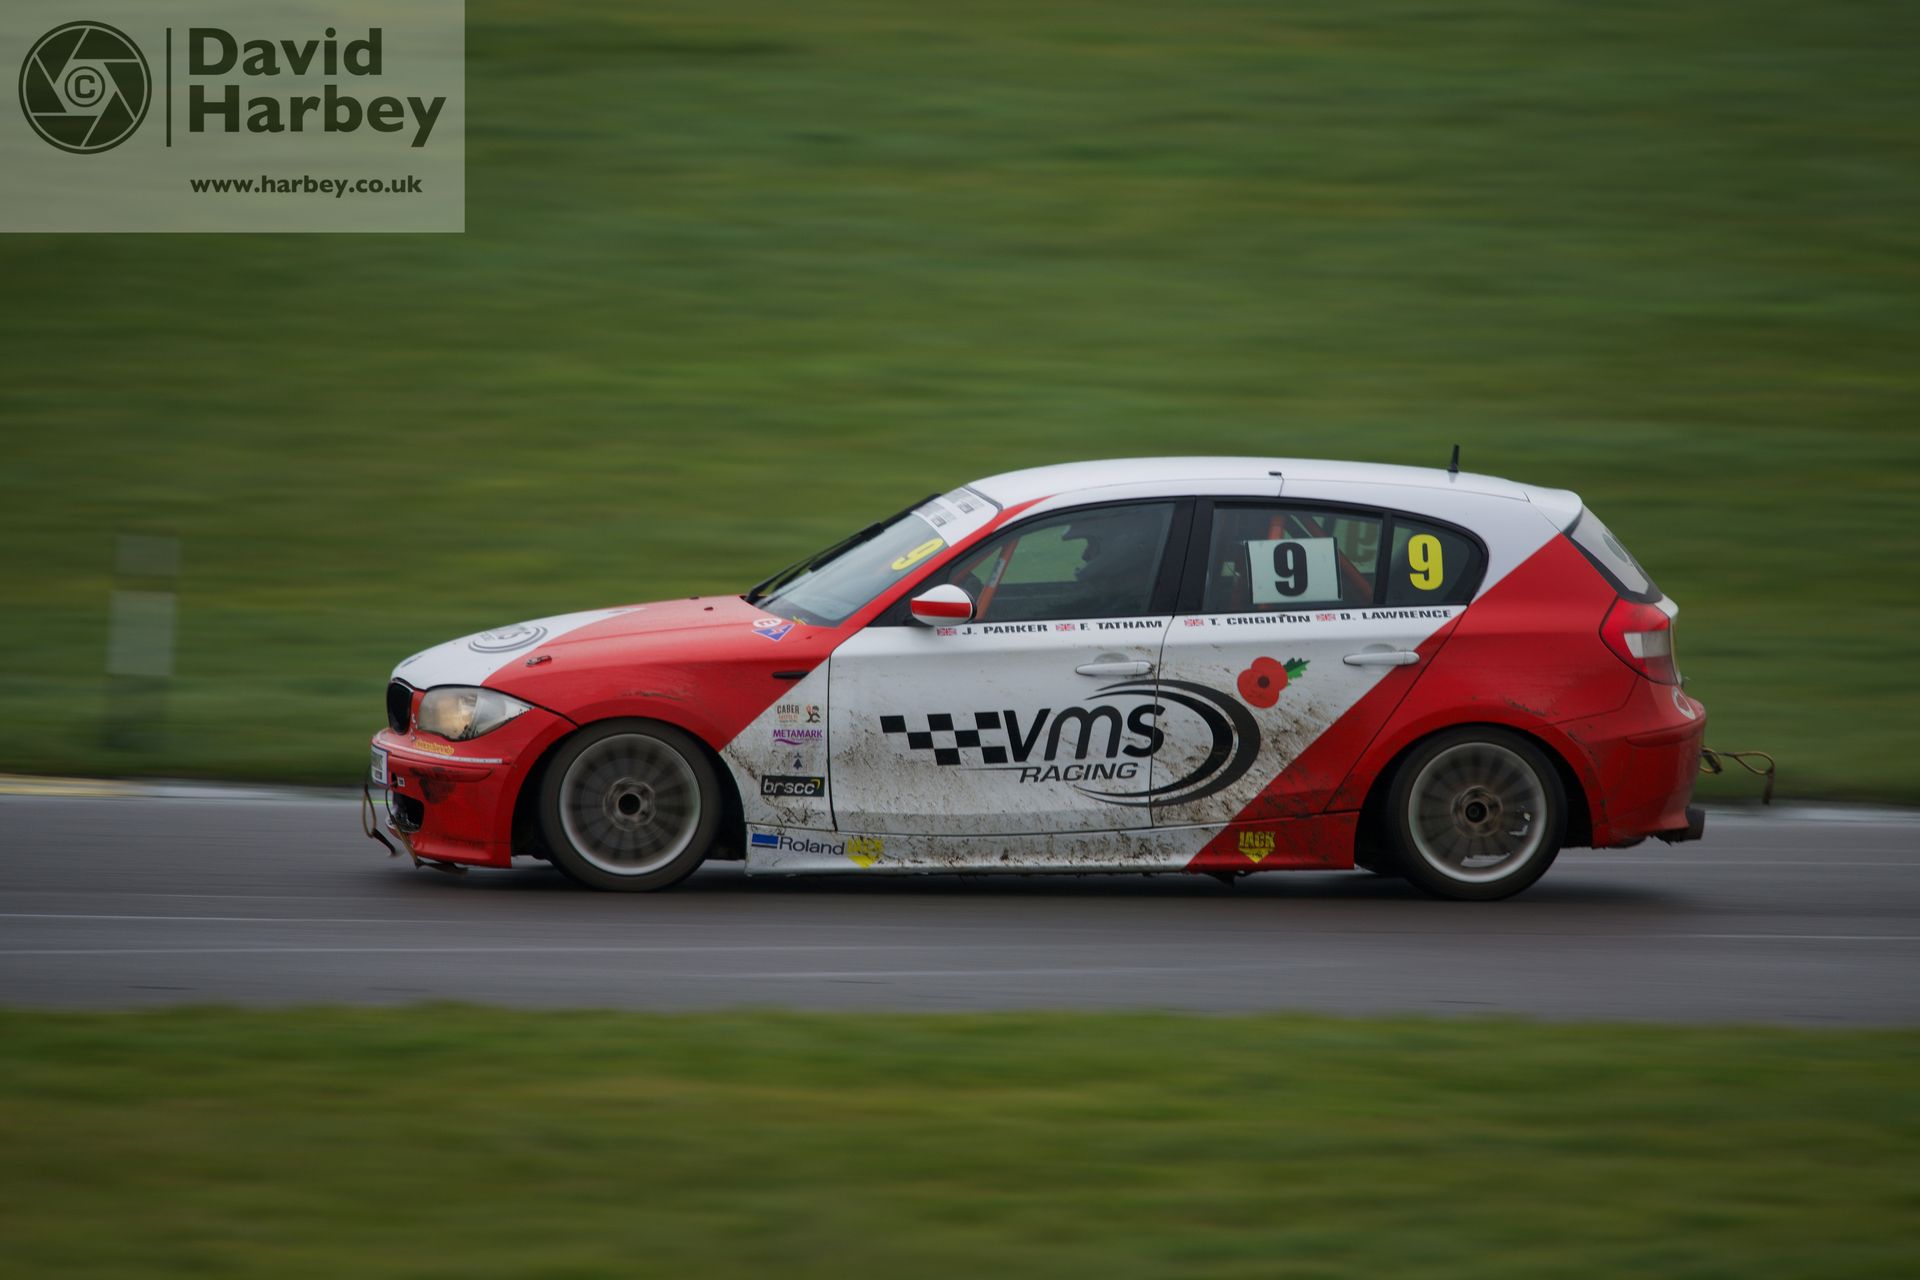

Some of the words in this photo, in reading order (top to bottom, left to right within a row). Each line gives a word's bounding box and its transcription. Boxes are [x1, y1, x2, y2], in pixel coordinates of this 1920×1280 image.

[891, 538, 944, 570] 9
[1408, 534, 1443, 590] 9
[1273, 542, 1308, 597] 9
[1226, 614, 1310, 625] CRIGHTON
[1362, 610, 1452, 620] LAWRENCE
[983, 624, 1049, 635] PARKER
[1099, 620, 1163, 630] TATHAM
[773, 729, 823, 738] METAMARK
[1020, 762, 1138, 783] RACING
[763, 779, 815, 795] brscc
[779, 836, 845, 856] Roland
